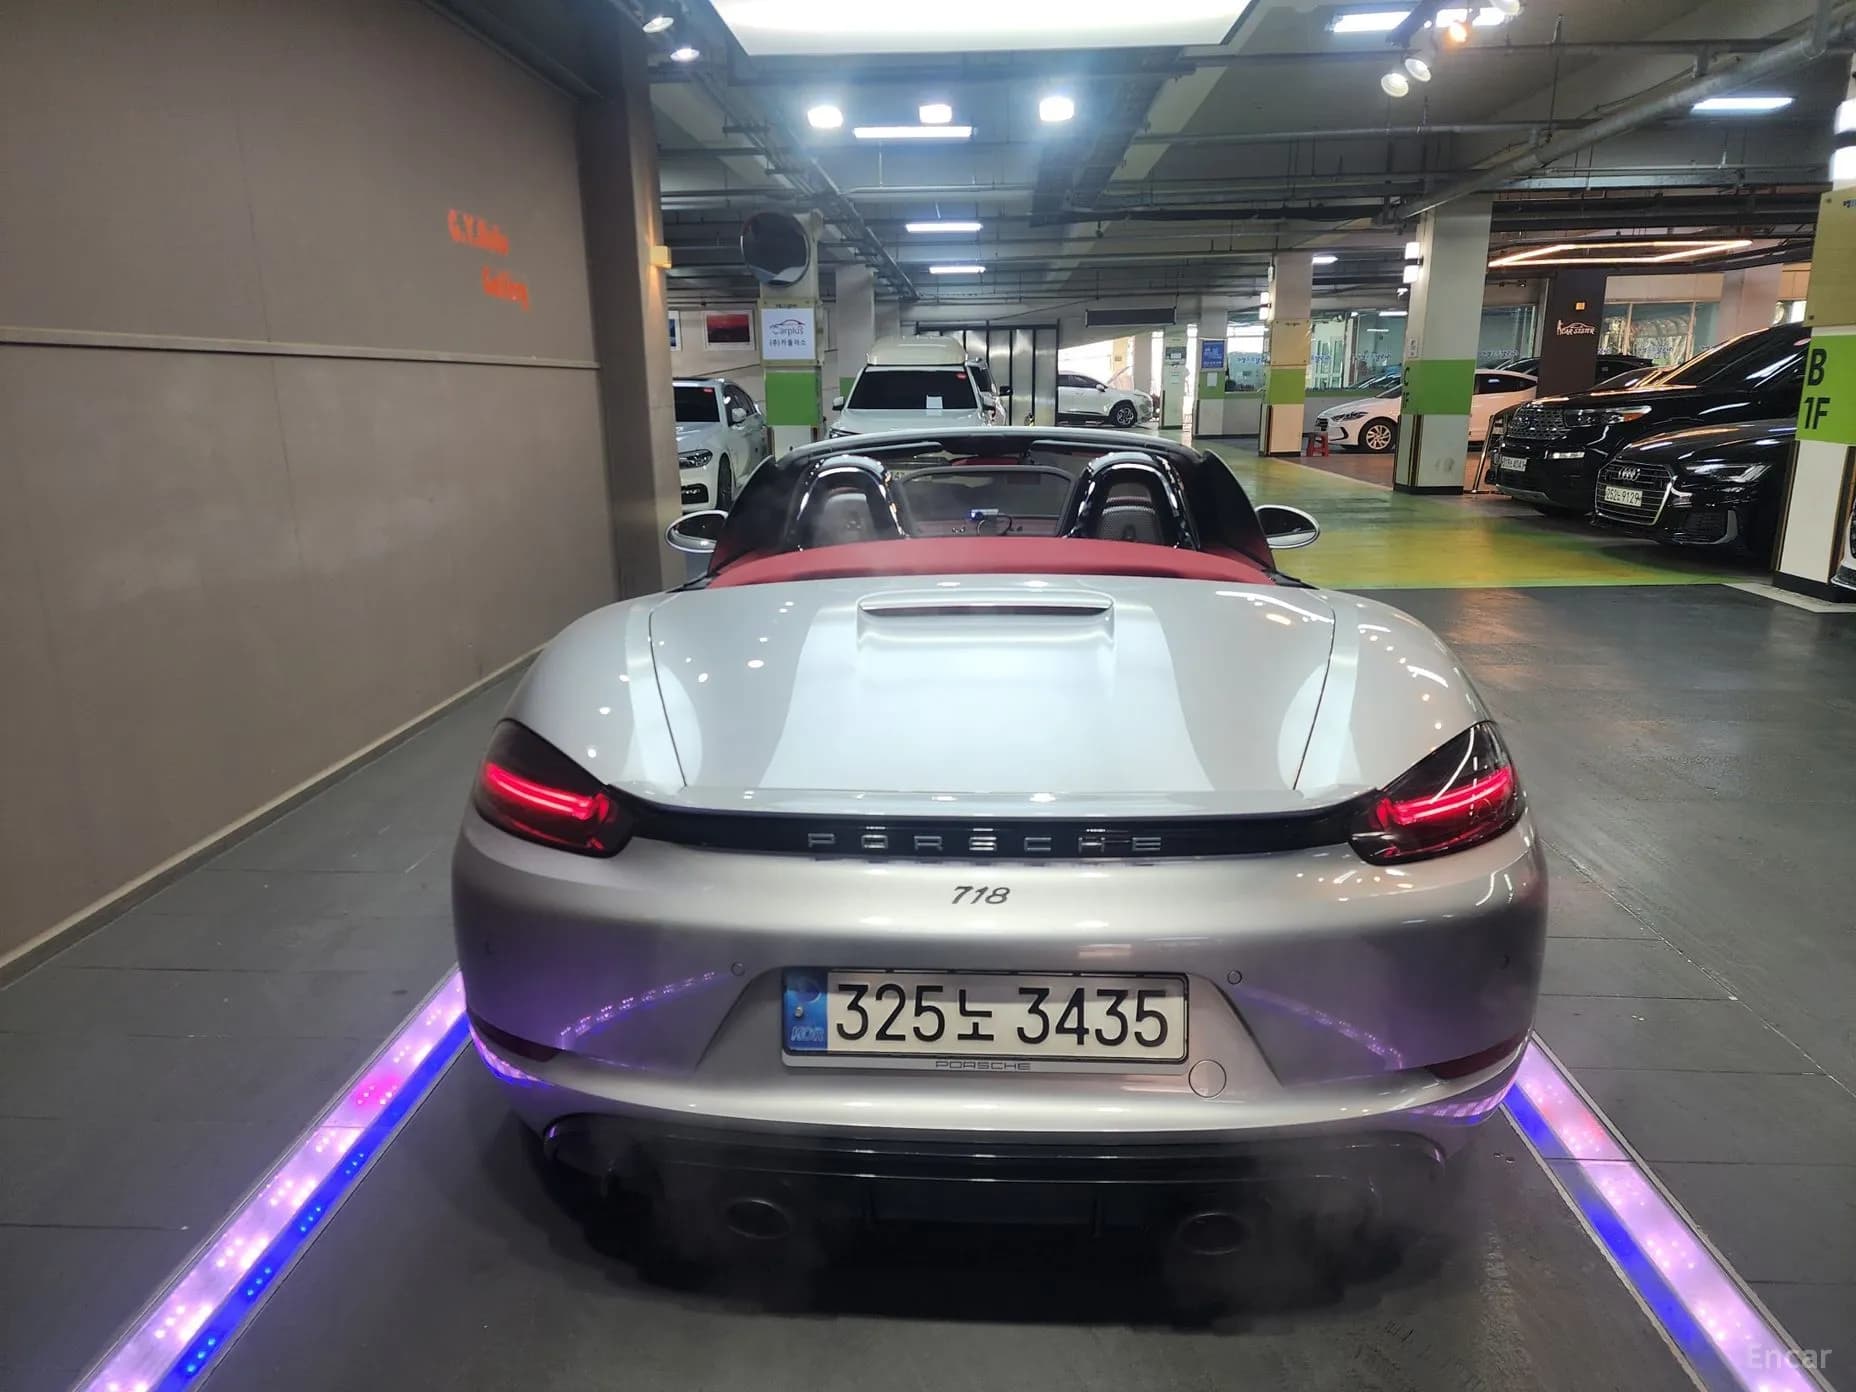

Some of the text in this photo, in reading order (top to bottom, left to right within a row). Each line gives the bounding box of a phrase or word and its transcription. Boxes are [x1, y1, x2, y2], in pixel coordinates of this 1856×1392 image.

[1808, 348, 1827, 386] B
[1803, 397, 1831, 430] 1F
[807, 832, 1162, 852] PORSCHE
[952, 886, 1010, 905] 718
[836, 983, 1169, 1048] 325노 3435
[935, 1060, 1031, 1071] PORSCHE
